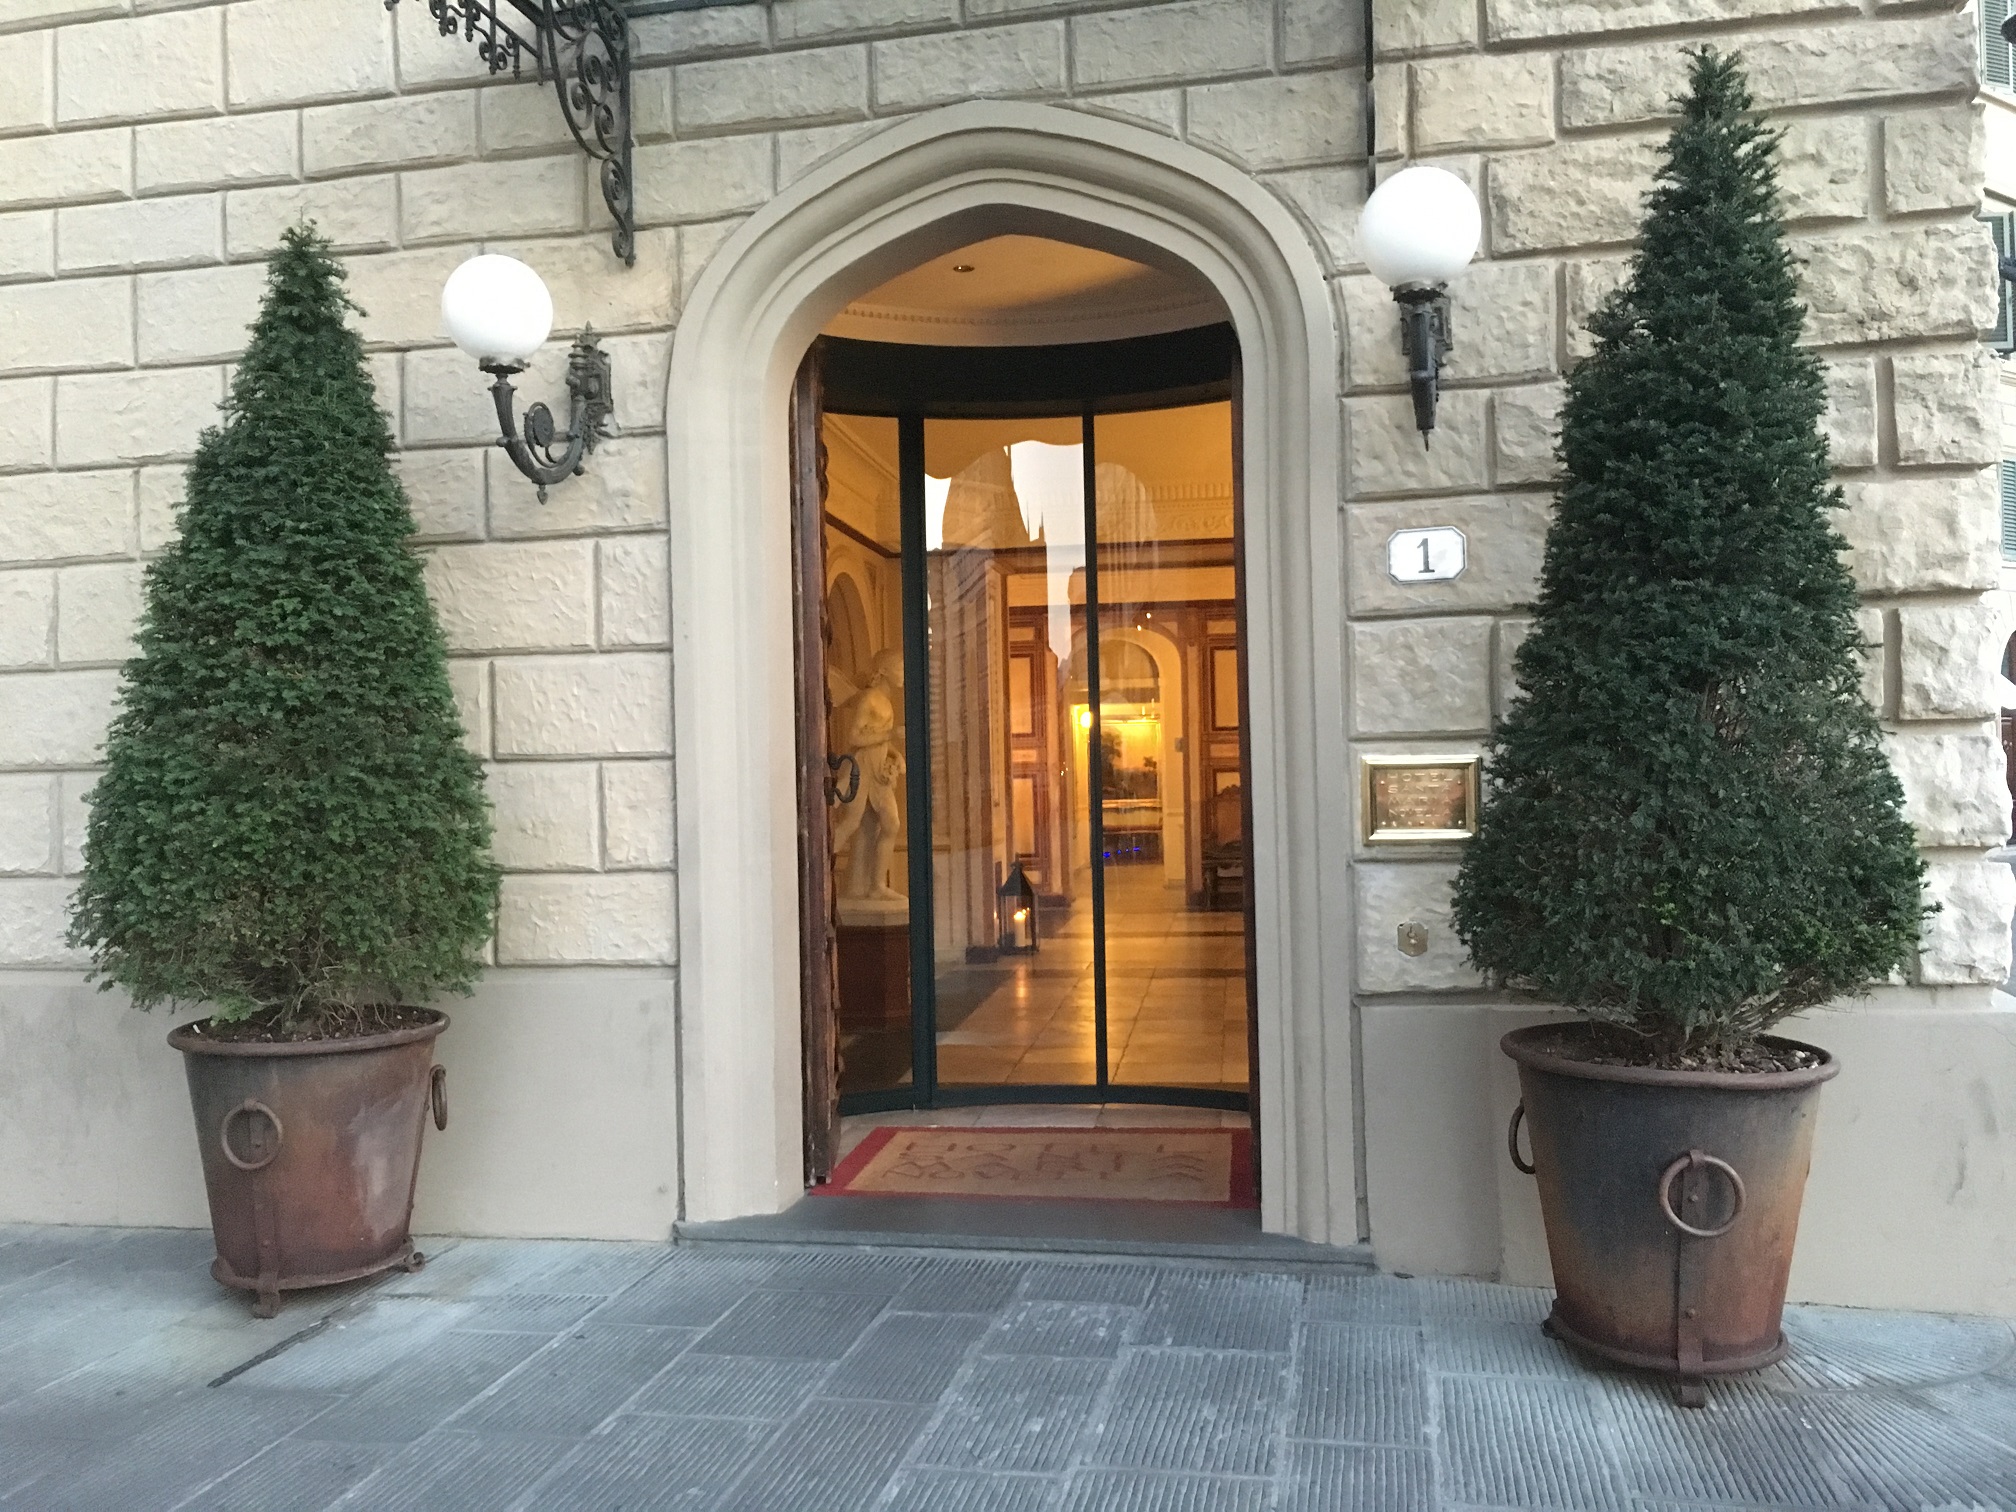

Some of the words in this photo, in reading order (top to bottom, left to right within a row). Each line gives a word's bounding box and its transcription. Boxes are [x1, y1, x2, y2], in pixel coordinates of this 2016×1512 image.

[1417, 538, 1435, 573] 1
[1387, 772, 1453, 782] HOTEL
[1387, 784, 1452, 794] SANTA
[1387, 796, 1453, 806] MARIA
